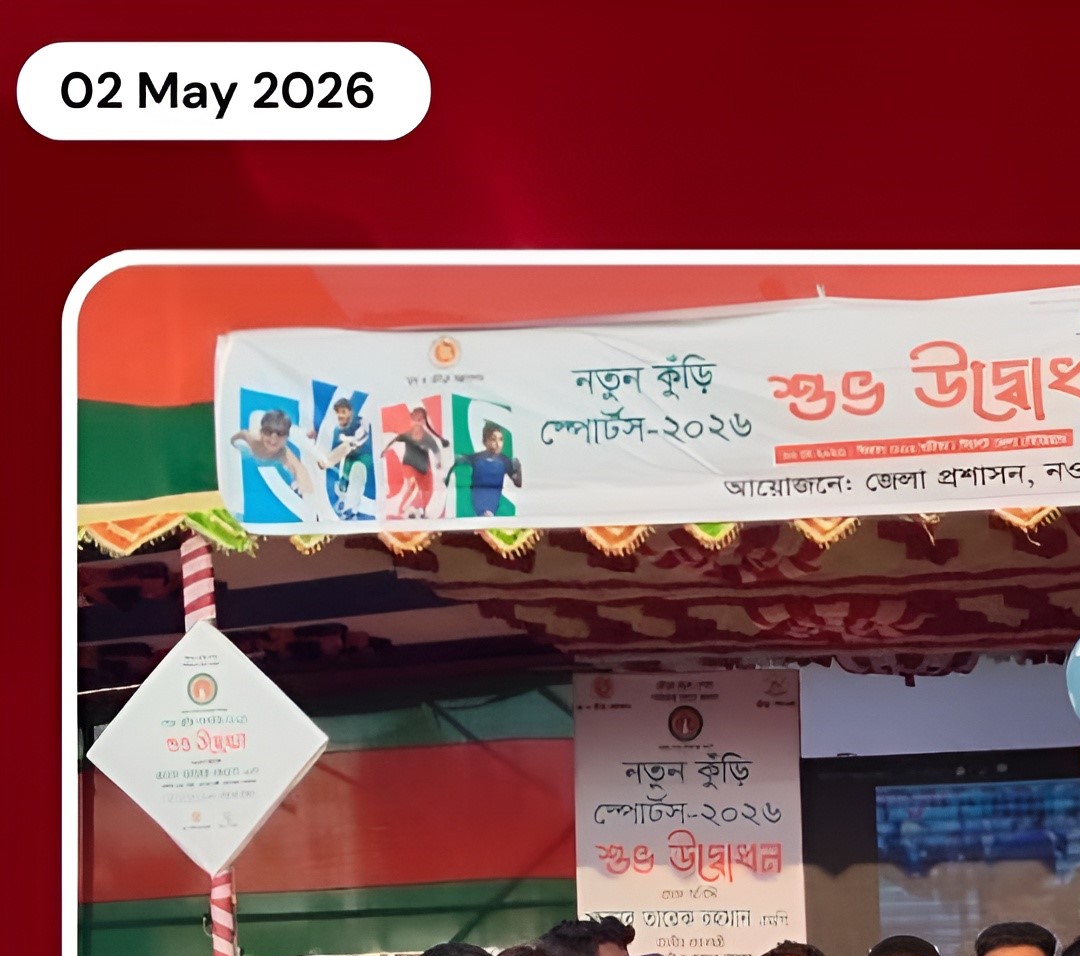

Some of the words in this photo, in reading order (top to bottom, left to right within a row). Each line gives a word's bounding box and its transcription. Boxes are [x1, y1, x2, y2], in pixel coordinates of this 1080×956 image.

[572, 366, 643, 399] নতুন
[651, 354, 717, 398] কুঁড়ি
[768, 371, 885, 421] শুভ
[540, 406, 752, 446] স্পোর্টস-২০২৬
[622, 762, 687, 789] নতুন
[695, 752, 753, 789] কুঁড়ি
[595, 844, 655, 875] শুভ
[667, 829, 782, 882] উদ্বোধন
